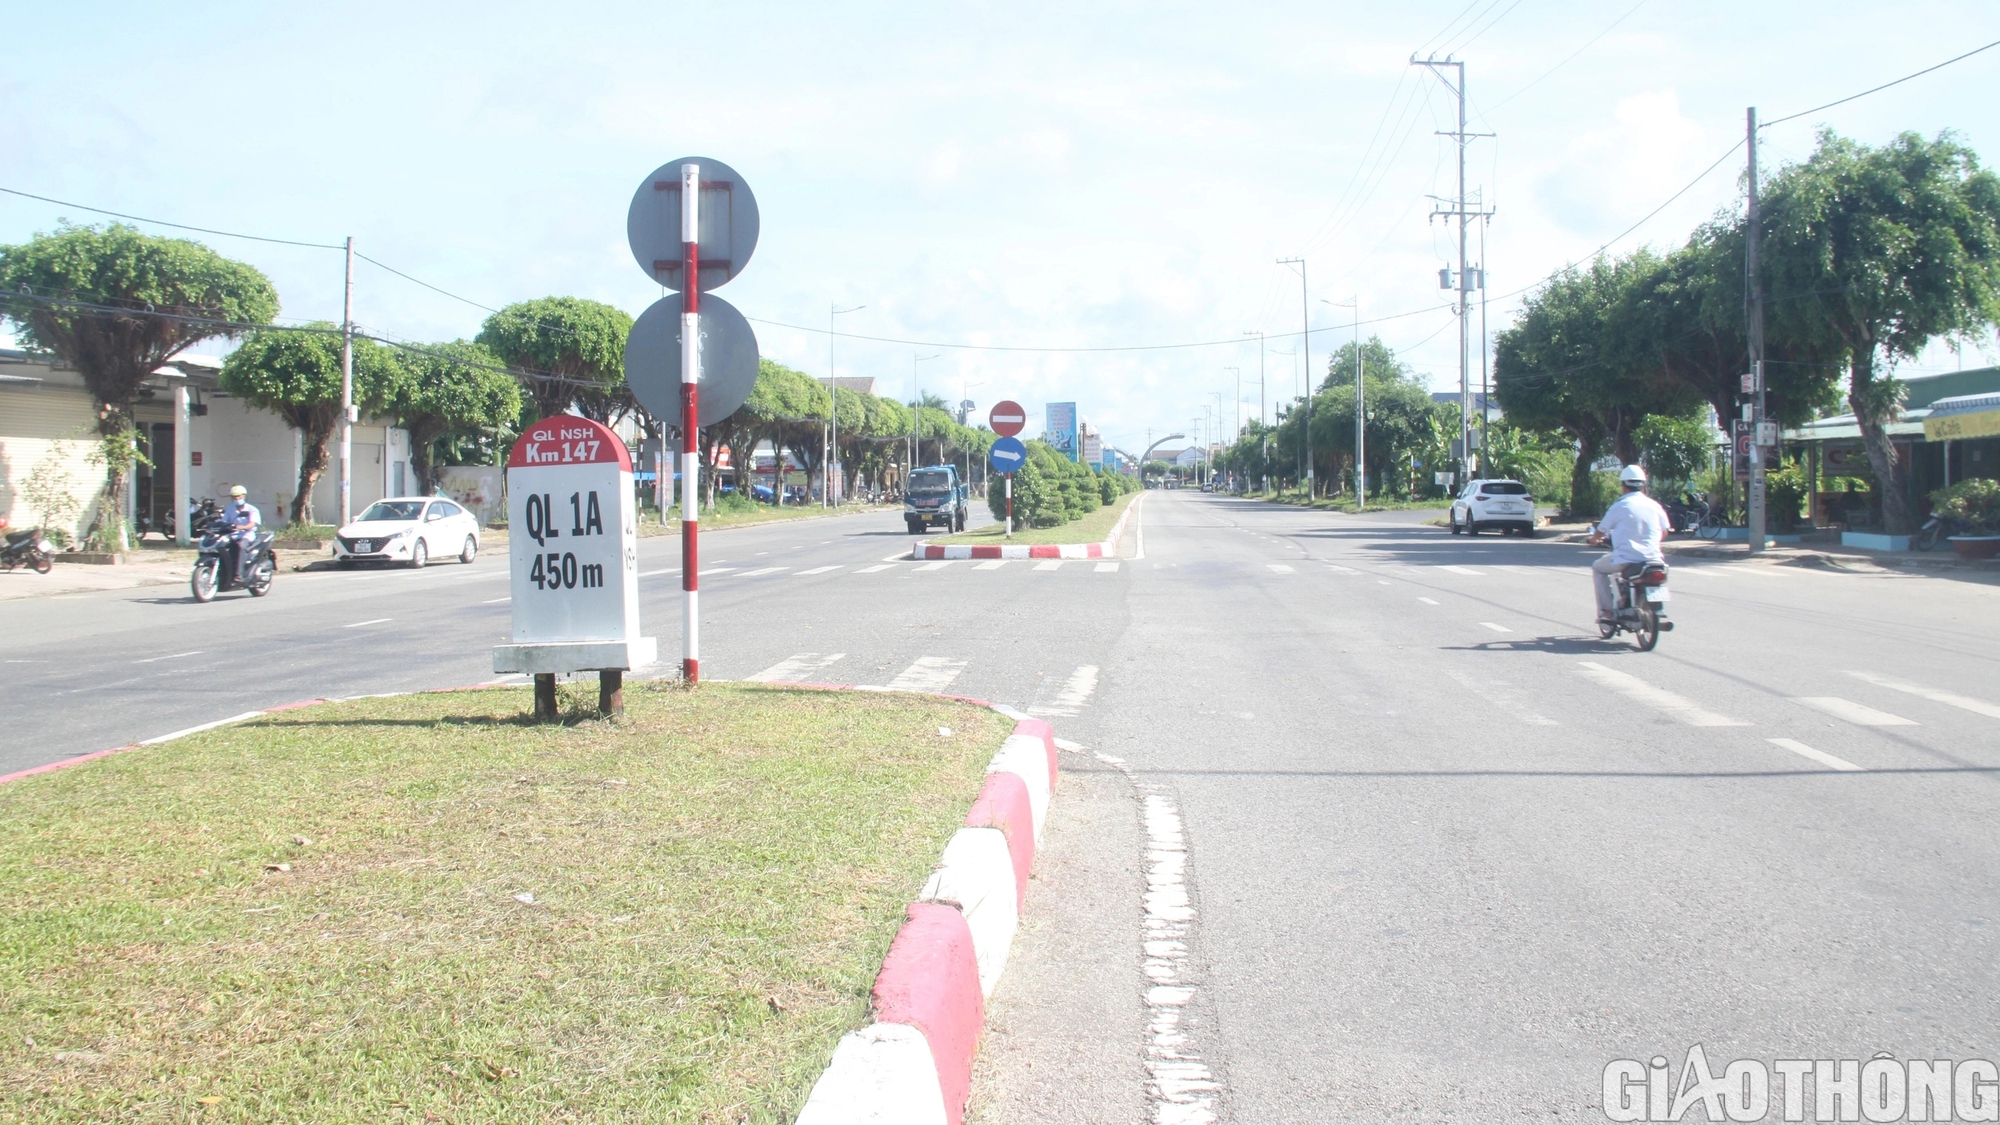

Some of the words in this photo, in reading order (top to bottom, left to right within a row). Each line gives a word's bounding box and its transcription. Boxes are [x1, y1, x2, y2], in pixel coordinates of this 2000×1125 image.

[532, 430, 555, 441] QL
[560, 427, 594, 440] NSH
[525, 493, 559, 547] QL
[570, 491, 604, 537] 1A
